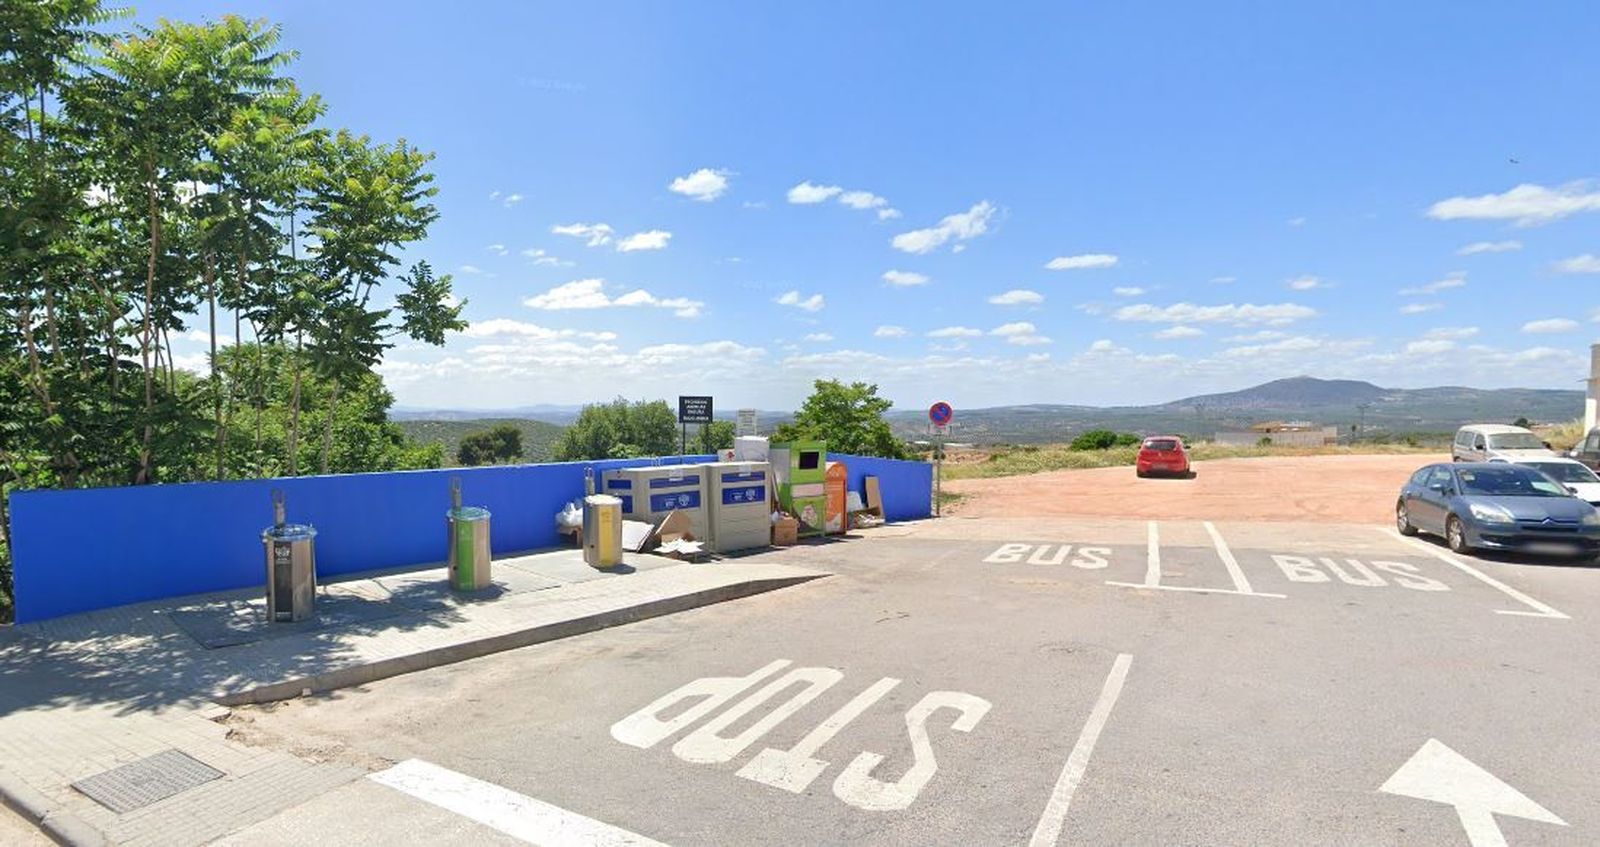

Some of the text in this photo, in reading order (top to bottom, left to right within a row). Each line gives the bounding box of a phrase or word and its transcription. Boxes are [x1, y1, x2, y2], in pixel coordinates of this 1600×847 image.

[983, 543, 1112, 570] BUS
[1271, 554, 1450, 592] BUS
[610, 658, 992, 812] STOP
